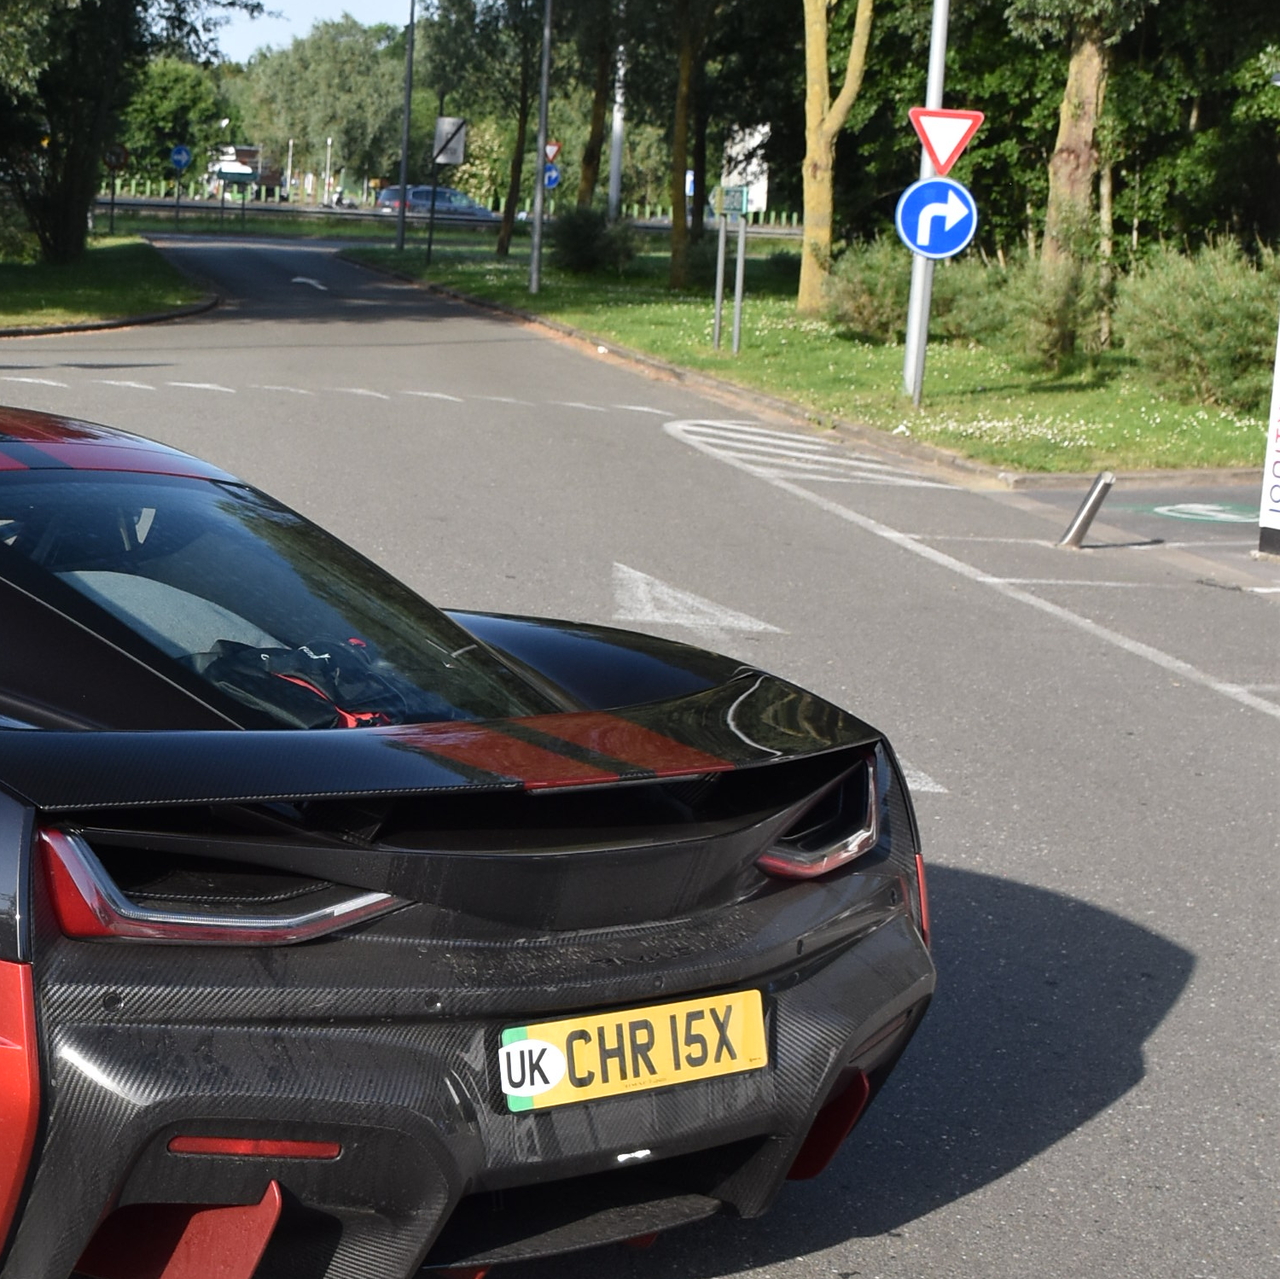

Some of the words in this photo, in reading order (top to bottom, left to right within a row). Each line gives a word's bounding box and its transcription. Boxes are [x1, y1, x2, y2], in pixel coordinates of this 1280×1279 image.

[506, 1047, 552, 1089] UK
[565, 1018, 658, 1089] CHR
[669, 1004, 738, 1072] 15X
